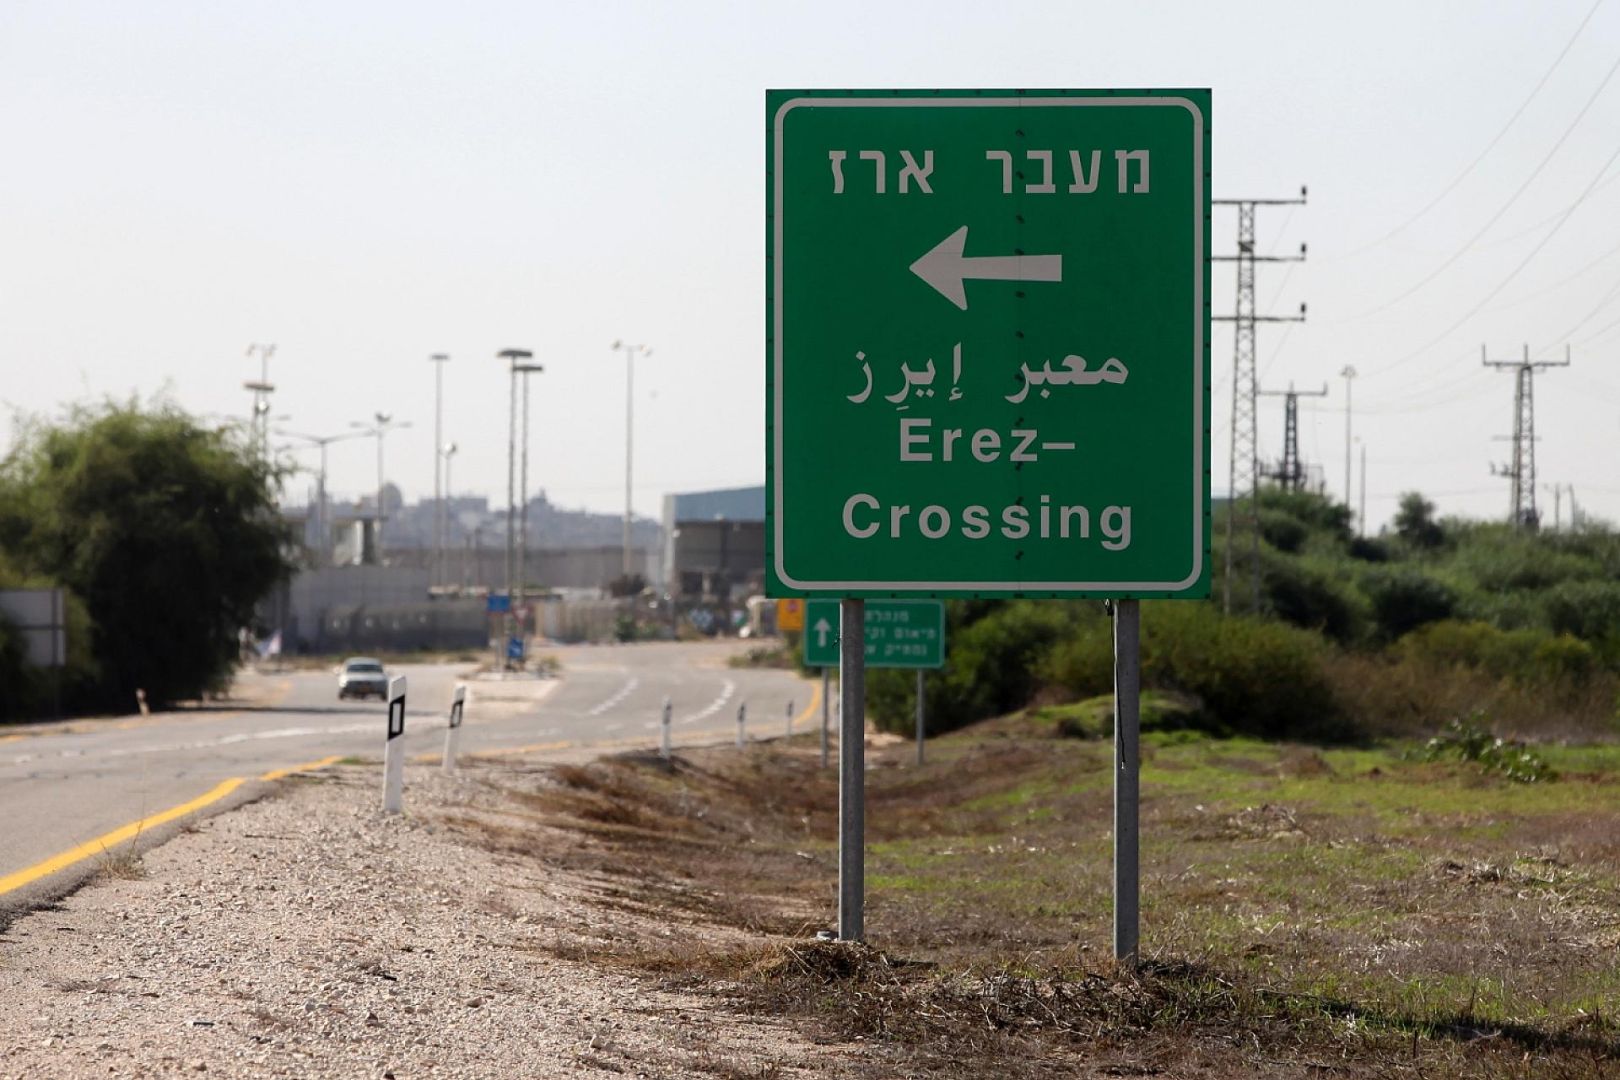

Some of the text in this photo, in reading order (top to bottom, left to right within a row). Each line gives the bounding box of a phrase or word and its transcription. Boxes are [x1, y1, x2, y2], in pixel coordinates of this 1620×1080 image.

[828, 149, 1150, 194] מעבר ארז
[1005, 354, 1129, 404] معبر
[842, 493, 1132, 551] Crossing
